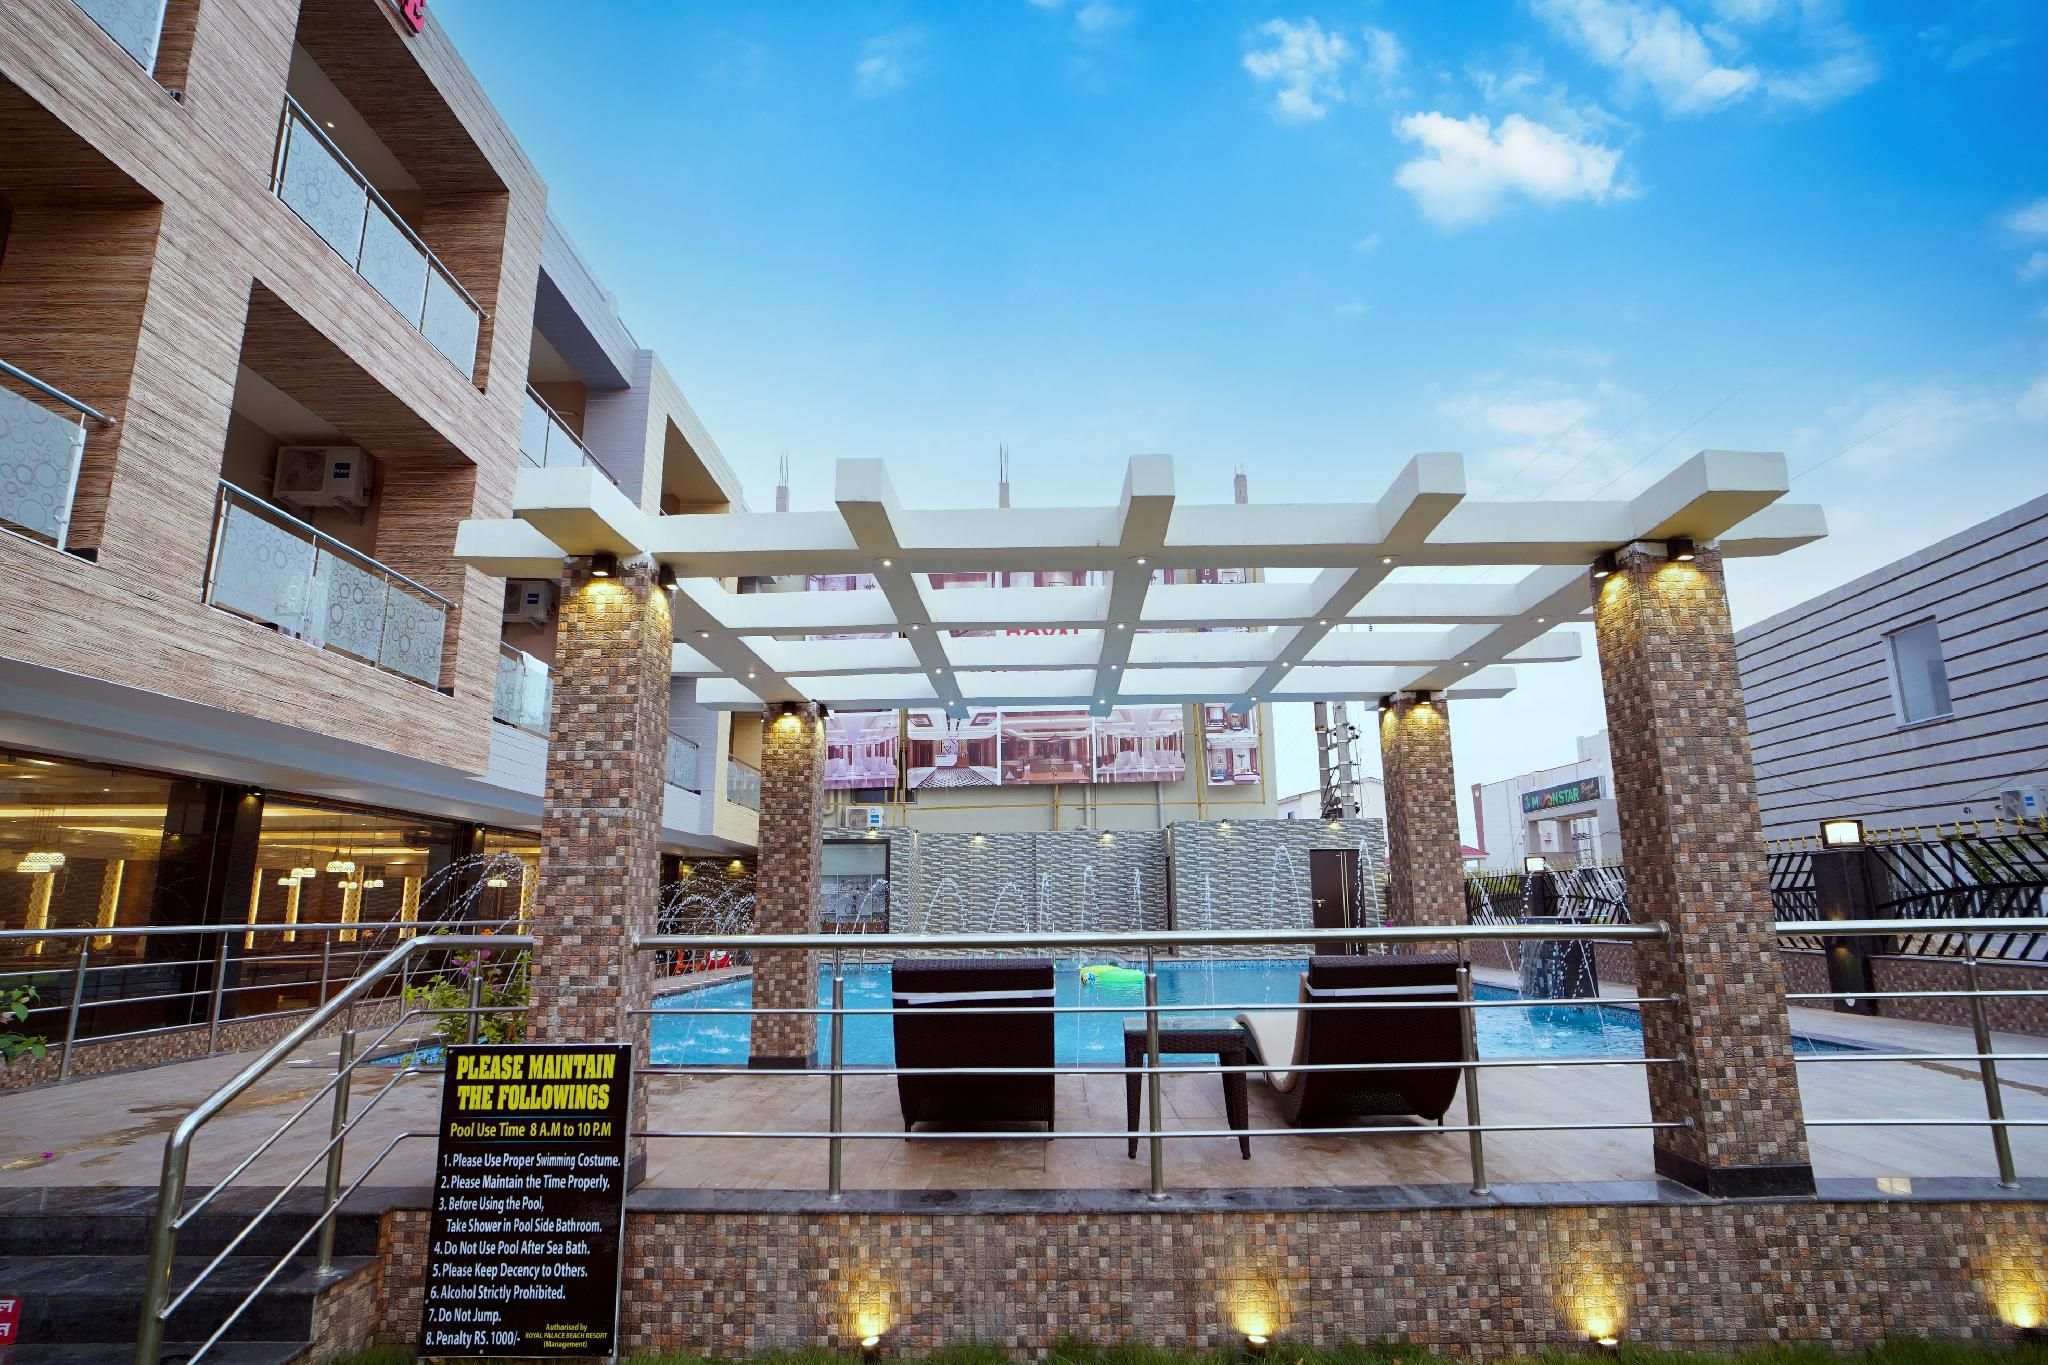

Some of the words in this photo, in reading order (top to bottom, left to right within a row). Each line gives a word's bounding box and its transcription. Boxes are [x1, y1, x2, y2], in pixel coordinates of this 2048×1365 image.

[1531, 787, 1580, 809] MOONSTAR
[456, 1054, 525, 1080] PLEASE
[528, 1053, 617, 1080] MAINTAIN
[457, 1085, 494, 1110] THE
[497, 1084, 610, 1110] FOLLOWINGS
[450, 1122, 475, 1137] Pool
[477, 1123, 497, 1137] Use
[500, 1121, 526, 1137] Time
[530, 1122, 537, 1137] 8
[539, 1122, 561, 1137] A.M
[564, 1124, 575, 1137] to
[578, 1122, 591, 1137] 10
[593, 1122, 612, 1137] P.M
[453, 1153, 483, 1167] Please
[484, 1154, 501, 1167] Use
[503, 1153, 535, 1170] Proper
[536, 1153, 576, 1170] Swimming
[578, 1153, 621, 1167] Costume.
[451, 1175, 481, 1189] Please
[482, 1174, 523, 1189] Maintain
[526, 1174, 541, 1188] the
[543, 1174, 566, 1188] Time
[568, 1174, 610, 1191] Properly.
[439, 1197, 448, 1211] 3.
[449, 1196, 478, 1210] Before
[480, 1196, 504, 1214] Using
[506, 1196, 521, 1210] the
[522, 1195, 545, 1212] Pool,
[447, 1218, 467, 1233] Take
[469, 1218, 502, 1232] Shower
[503, 1218, 512, 1232] in
[514, 1218, 534, 1232] Pool
[535, 1217, 555, 1232] Side
[556, 1217, 602, 1233] Bathroom.
[444, 1241, 458, 1255] Do
[460, 1240, 477, 1255] Not
[479, 1241, 496, 1255] Use
[498, 1240, 519, 1255] Pool
[521, 1240, 545, 1255] After
[546, 1240, 563, 1255] Sea
[565, 1240, 591, 1255] Bath.
[442, 1263, 473, 1278] Please
[474, 1263, 498, 1280] Keep
[500, 1263, 540, 1280] Decency
[542, 1264, 551, 1278] to
[554, 1262, 588, 1278] Others.
[441, 1285, 477, 1300] Alcohol
[478, 1285, 512, 1303] Strictly
[513, 1285, 566, 1300] Prohibited.
[438, 1308, 452, 1322] Do
[454, 1308, 472, 1322] Not
[473, 1308, 502, 1326] Jump.
[546, 1323, 579, 1331] Authorised
[580, 1323, 588, 1332] by
[436, 1331, 473, 1349] Penalty
[474, 1331, 490, 1345] RS.
[491, 1331, 521, 1346] 1000/-
[543, 1341, 588, 1349] (Management)
